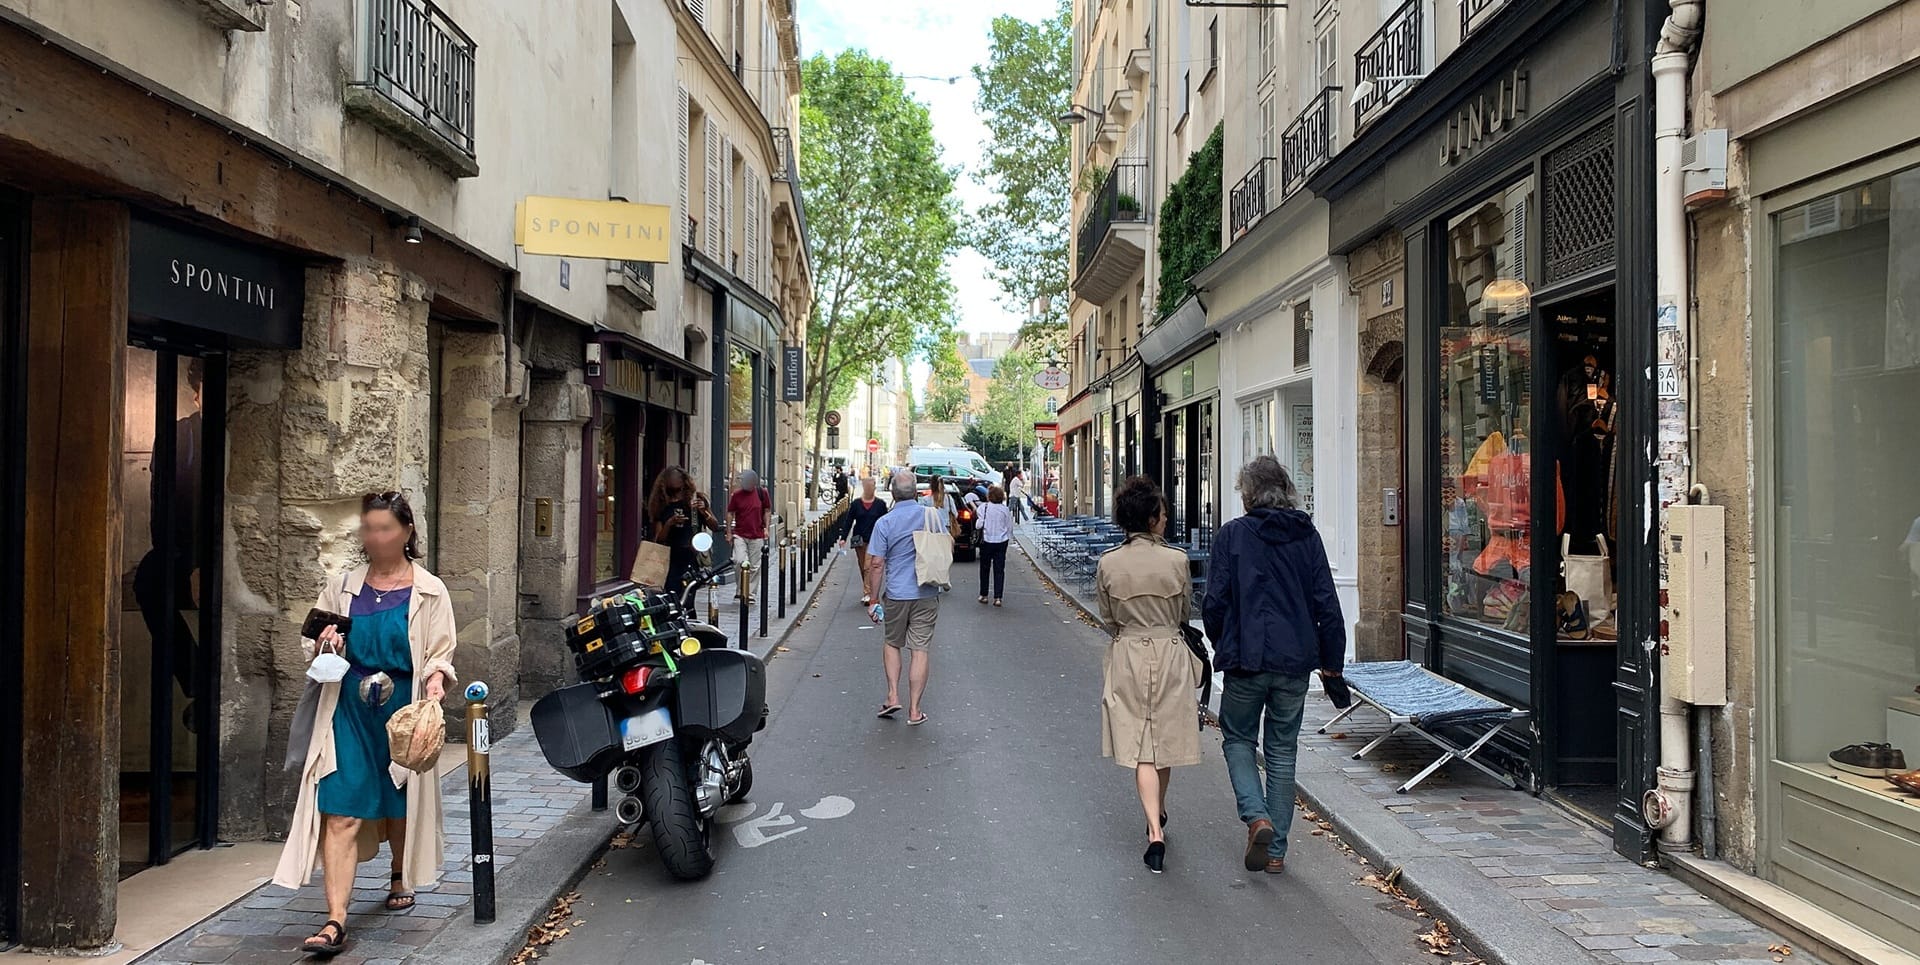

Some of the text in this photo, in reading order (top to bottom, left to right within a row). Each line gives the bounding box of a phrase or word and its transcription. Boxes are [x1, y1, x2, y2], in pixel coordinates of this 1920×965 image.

[1439, 63, 1521, 167] JINJI
[531, 216, 663, 242] SPONTINI
[171, 259, 274, 310] SPONTINI
[786, 350, 798, 396] Hartford
